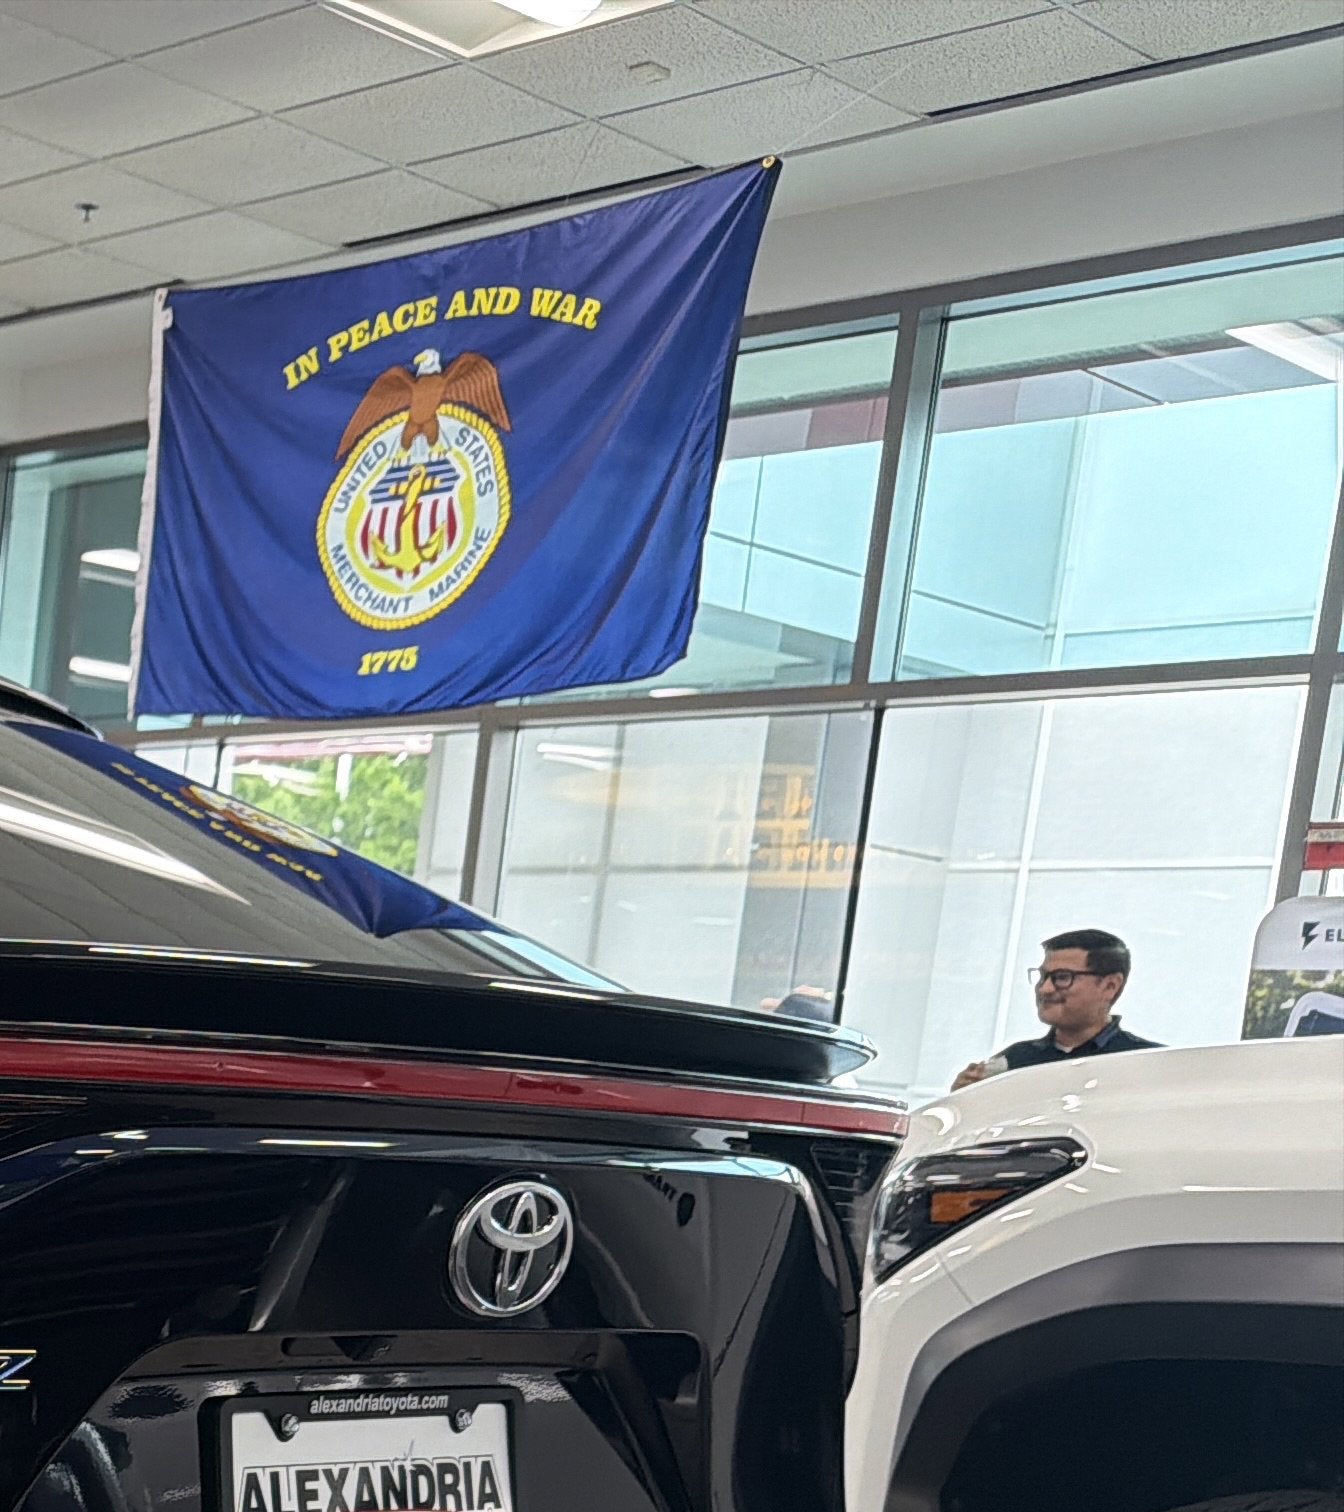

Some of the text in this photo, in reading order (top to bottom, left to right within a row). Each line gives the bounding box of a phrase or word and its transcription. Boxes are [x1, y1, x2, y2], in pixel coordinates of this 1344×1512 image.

[283, 286, 602, 390] IN PEACE AND WAR
[334, 427, 494, 513] UNITED STATES
[330, 526, 491, 614] MERCHANT MARINE
[357, 645, 420, 676] 1775
[310, 1394, 448, 1416] alexandriatoyota.com
